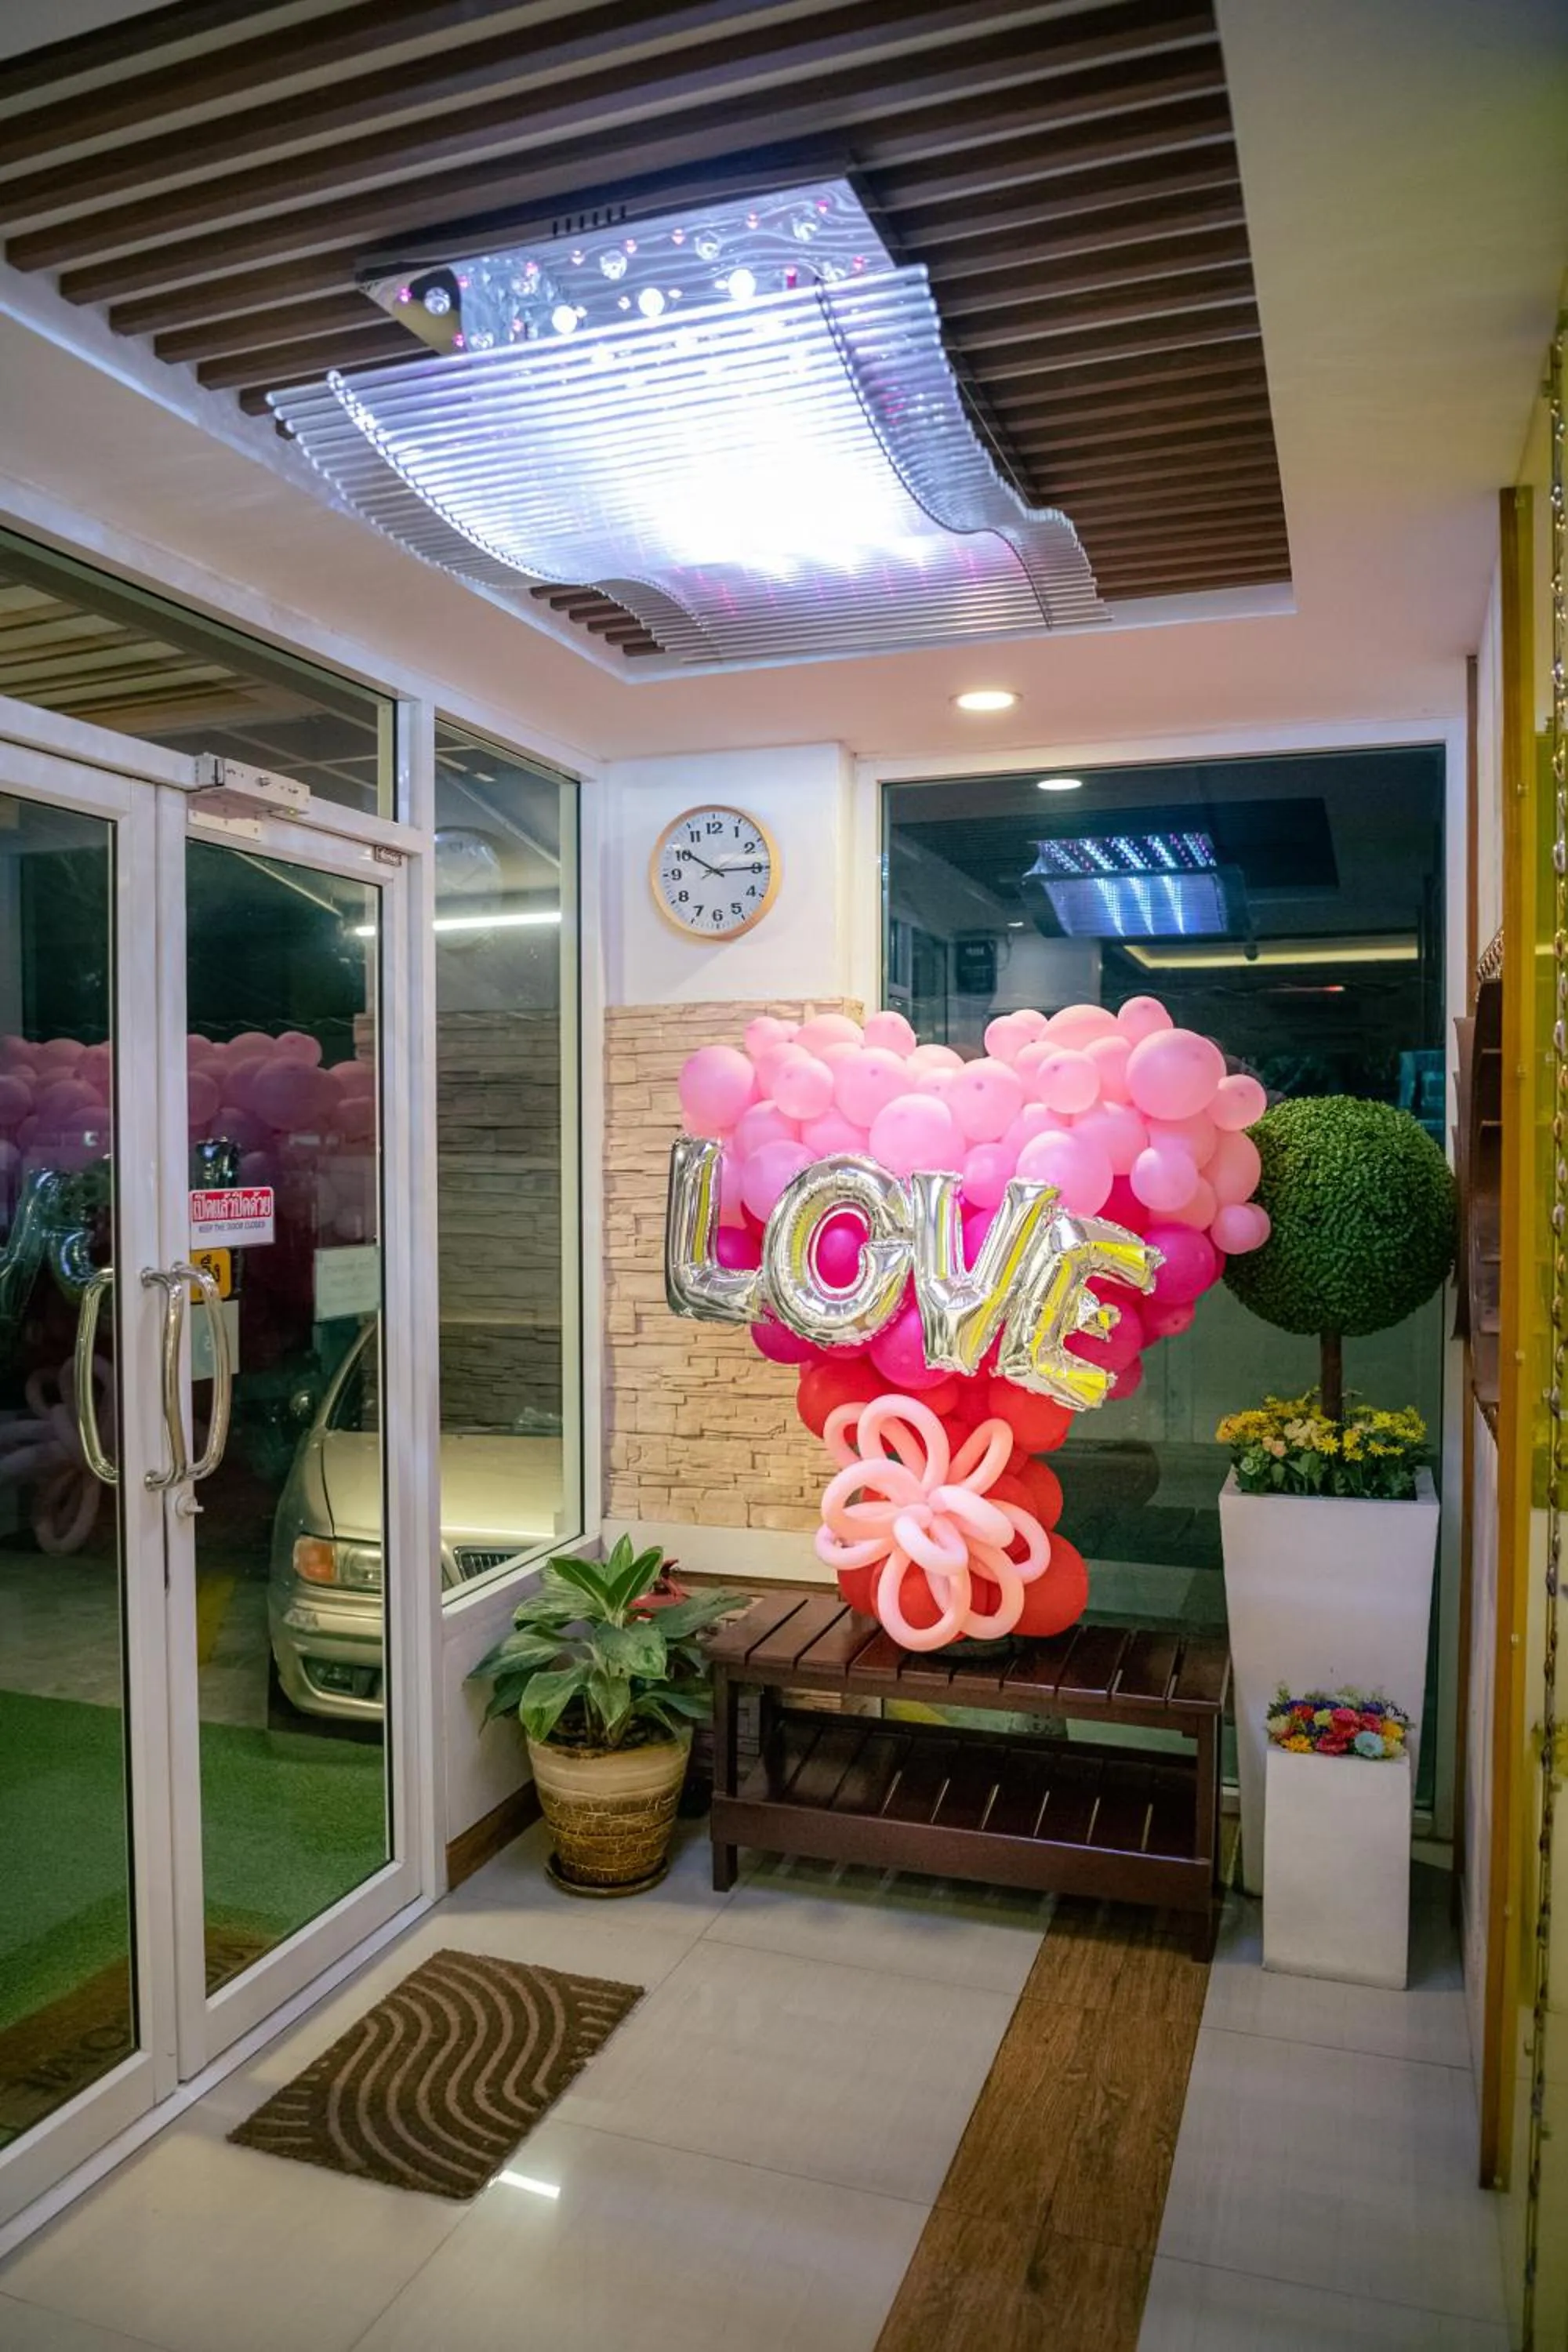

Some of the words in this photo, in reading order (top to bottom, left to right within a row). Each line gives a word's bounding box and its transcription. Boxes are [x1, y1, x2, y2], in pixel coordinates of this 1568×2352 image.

[706, 822, 723, 834] 12
[734, 826, 740, 838] 1
[690, 830, 701, 843] 11
[744, 841, 756, 854] 2
[676, 850, 691, 862] 10
[751, 862, 762, 874] 3
[671, 869, 682, 880] 9
[678, 890, 689, 902] 8
[746, 885, 756, 897] 4
[693, 905, 704, 916] 7
[731, 902, 742, 914] 5
[713, 909, 724, 921] 6
[664, 1135, 1167, 1411] LOVE
